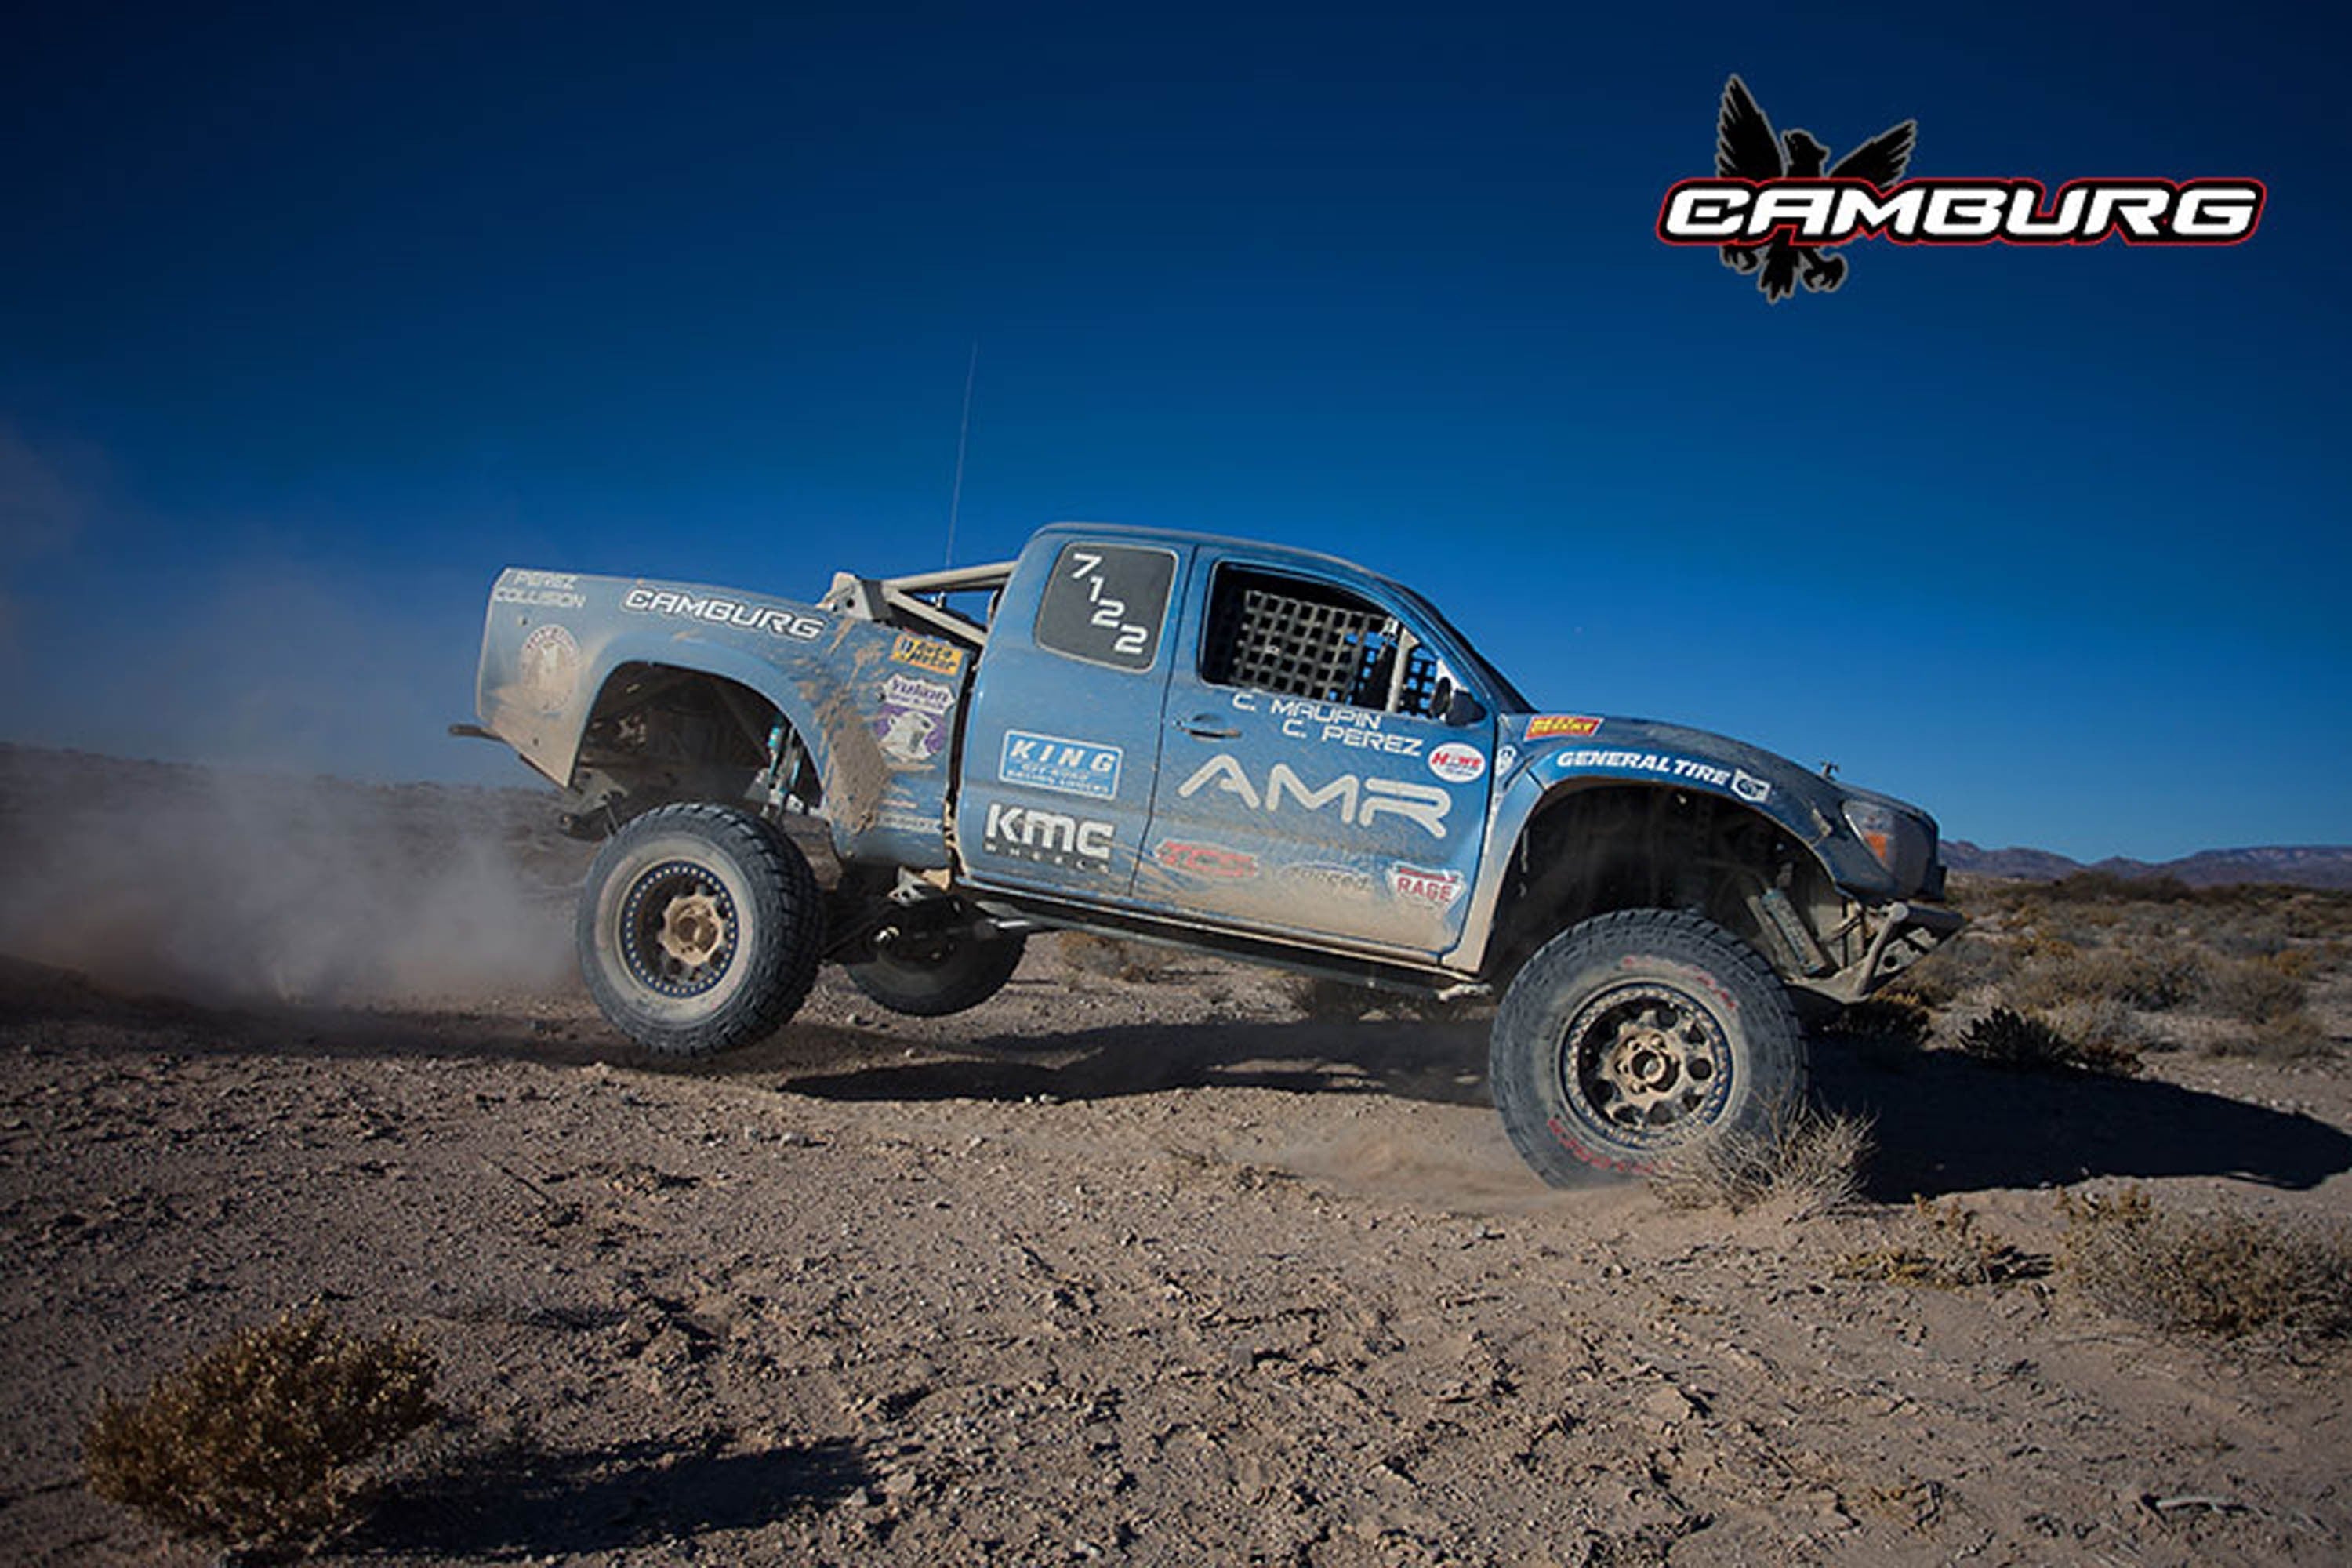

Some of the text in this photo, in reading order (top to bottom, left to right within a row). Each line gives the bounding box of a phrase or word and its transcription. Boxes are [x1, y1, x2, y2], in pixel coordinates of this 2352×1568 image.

[626, 589, 825, 640] CAMBURG
[1072, 553, 1148, 654] 7122
[1232, 691, 1381, 730] C. MAUPIN
[1010, 739, 1116, 772] KING
[1282, 718, 1424, 757] C. PEREZ
[1557, 750, 1731, 786] GENERAL TIRE
[1178, 753, 1452, 839] AMR
[1397, 876, 1453, 902] RAGE
